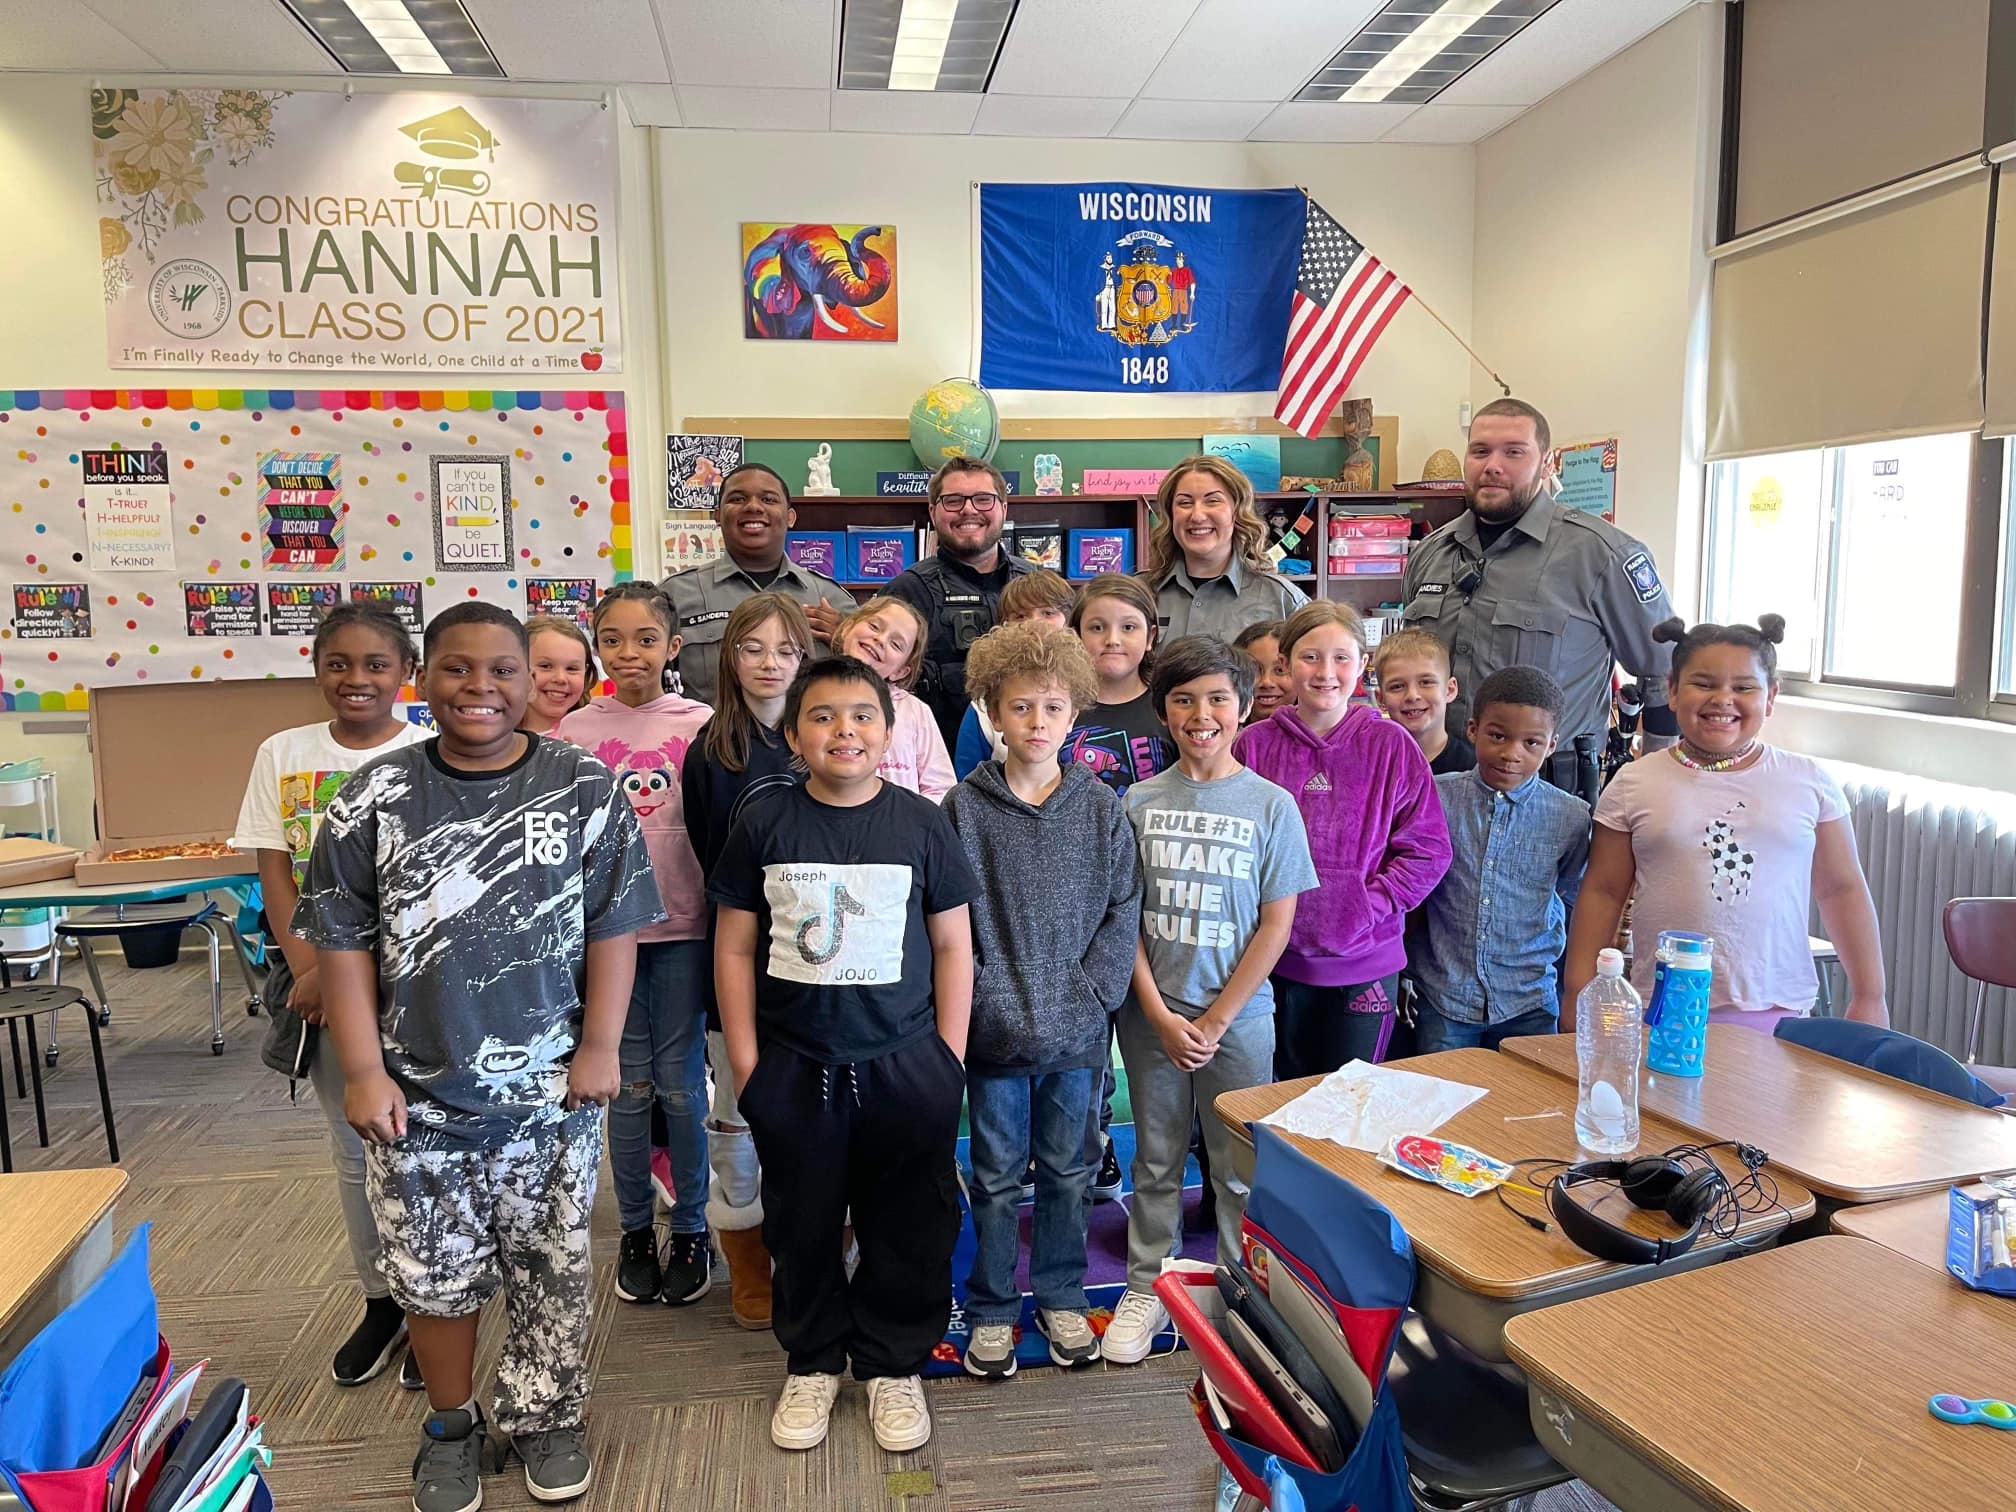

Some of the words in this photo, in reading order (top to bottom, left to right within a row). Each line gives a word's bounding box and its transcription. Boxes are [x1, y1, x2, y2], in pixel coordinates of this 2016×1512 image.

[226, 195, 599, 233] CONGRATULATIONS
[1079, 192, 1212, 223] WISCONSIN
[1129, 231, 1161, 241] FORWARD
[235, 227, 601, 298] HANNAH
[183, 322, 202, 330] 1968
[238, 299, 407, 342] CLASS
[422, 302, 489, 342] OF
[505, 306, 605, 344] 2021
[122, 347, 147, 361] I'm
[153, 348, 204, 365] Finally
[211, 349, 260, 366] Ready
[267, 351, 282, 364] to
[287, 351, 344, 368] Change
[351, 352, 377, 366] the
[381, 352, 432, 368] World,
[438, 354, 465, 367] One
[471, 354, 505, 368] Child
[510, 355, 525, 368] at
[531, 358, 540, 368] a
[545, 355, 579, 369] Time
[1121, 356, 1169, 385] 1848
[87, 453, 164, 474] THINK
[271, 460, 297, 474] DON'T
[298, 461, 324, 475] DECIDE
[86, 473, 115, 483] before
[117, 473, 134, 484] you
[278, 475, 302, 489] THAT
[305, 475, 323, 489] YOU
[453, 468, 460, 480] If
[463, 470, 486, 482] you
[898, 472, 930, 480] Difficult
[446, 481, 476, 493] can't
[479, 481, 495, 493] be
[107, 498, 148, 509] T-TRUE?
[280, 490, 318, 505] CAN'T
[446, 495, 497, 514] KIND,
[97, 512, 161, 524] H-HELPFUL?
[281, 520, 320, 534] DISCOVER
[665, 522, 682, 531] Sign
[684, 522, 720, 531] Languag
[465, 529, 481, 540] be
[281, 535, 306, 548] THAT
[309, 535, 327, 549] YOU
[289, 549, 316, 563] CAN
[446, 543, 502, 558] QUIET.
[800, 548, 824, 560] Rigby
[870, 547, 894, 560] Rigby
[1091, 546, 1114, 559] Rigby
[110, 555, 155, 567] K-KIND?
[23, 608, 55, 617] Follow
[215, 612, 238, 621] hand
[235, 605, 256, 614] your
[697, 611, 730, 623] SANDERS
[1303, 783, 1333, 791] adidas
[1149, 813, 1207, 834] RULE
[1211, 817, 1250, 842] #1:
[1151, 839, 1255, 880] MAKE
[778, 870, 827, 883] Joseph
[1156, 878, 1223, 913] THE
[1143, 910, 1238, 949] RULES
[835, 968, 877, 982] JOJO
